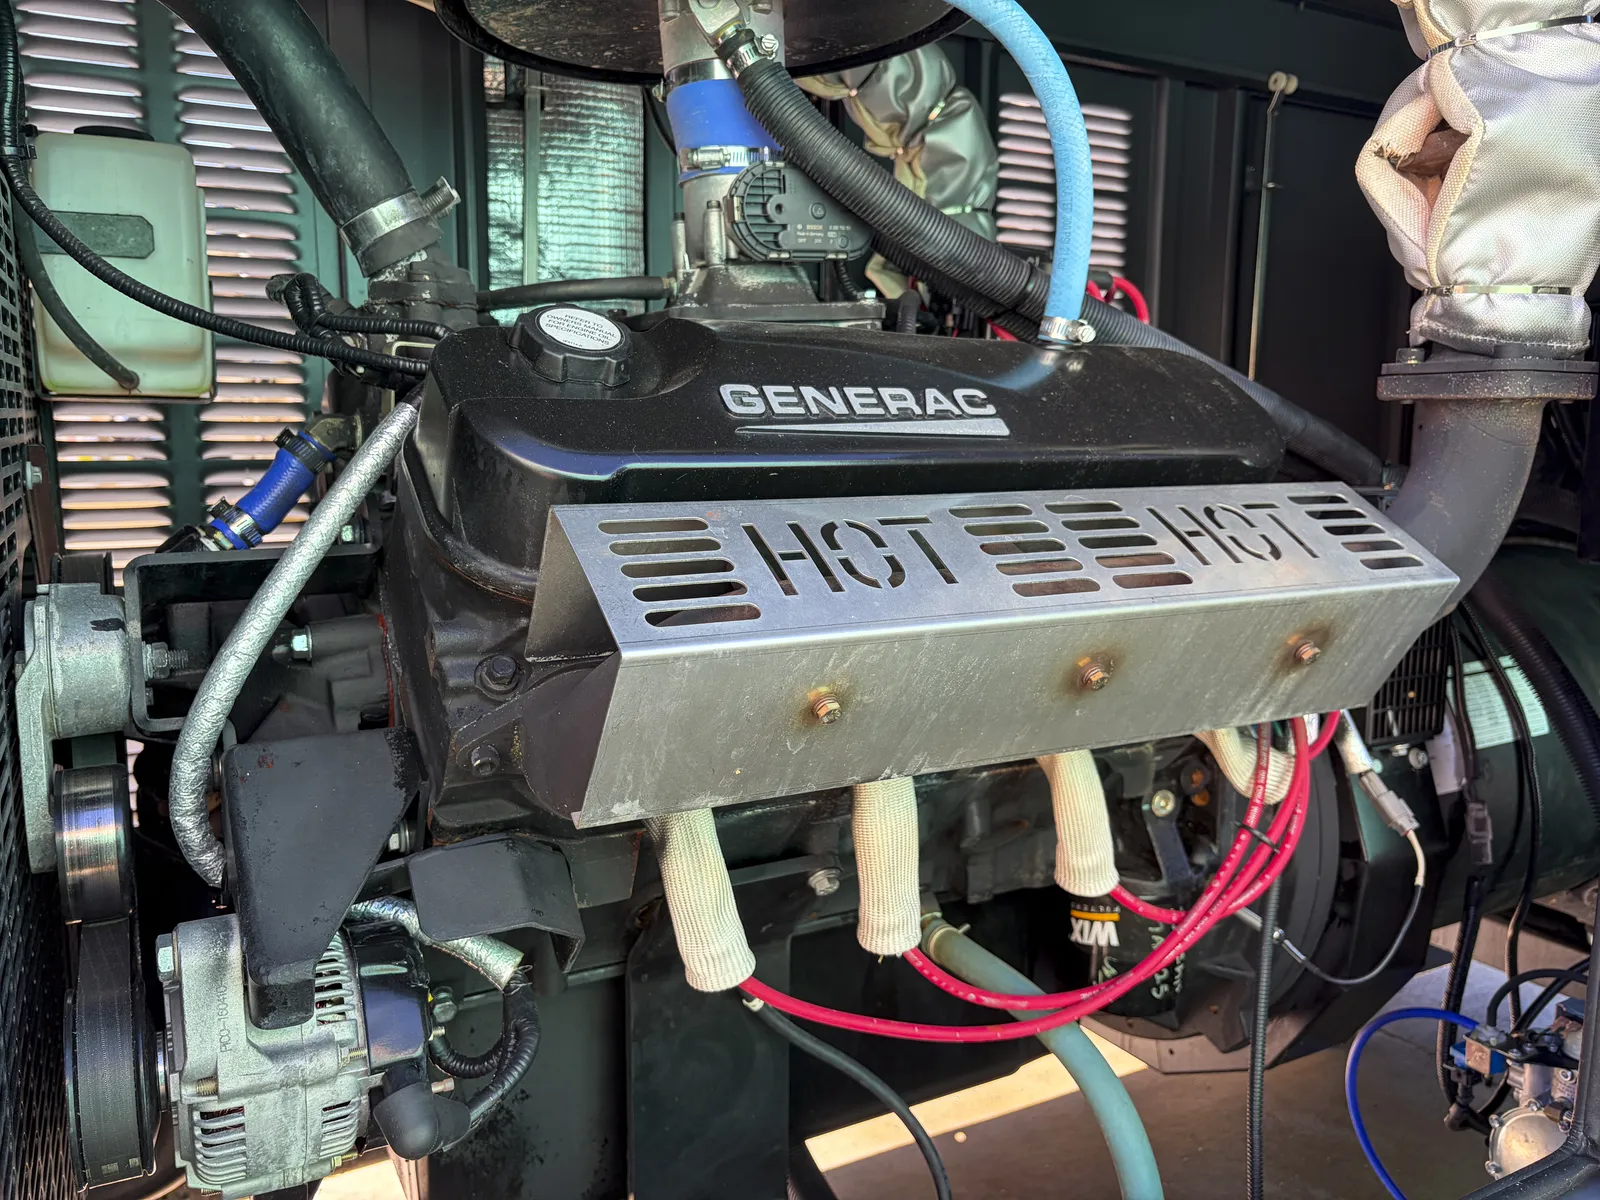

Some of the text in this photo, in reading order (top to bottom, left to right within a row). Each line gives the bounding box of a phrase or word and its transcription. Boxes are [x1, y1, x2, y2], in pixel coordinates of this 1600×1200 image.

[545, 323, 611, 346] SPECIFICATIONS
[546, 314, 617, 338] OWNERS MANUAL
[548, 319, 611, 341] FOR ENGINE OIL
[564, 314, 604, 329] REFER TO
[719, 384, 998, 417] GENERAC
[1145, 502, 1321, 566] HOT
[740, 517, 960, 596] HOT
[1069, 917, 1120, 947] WIX
